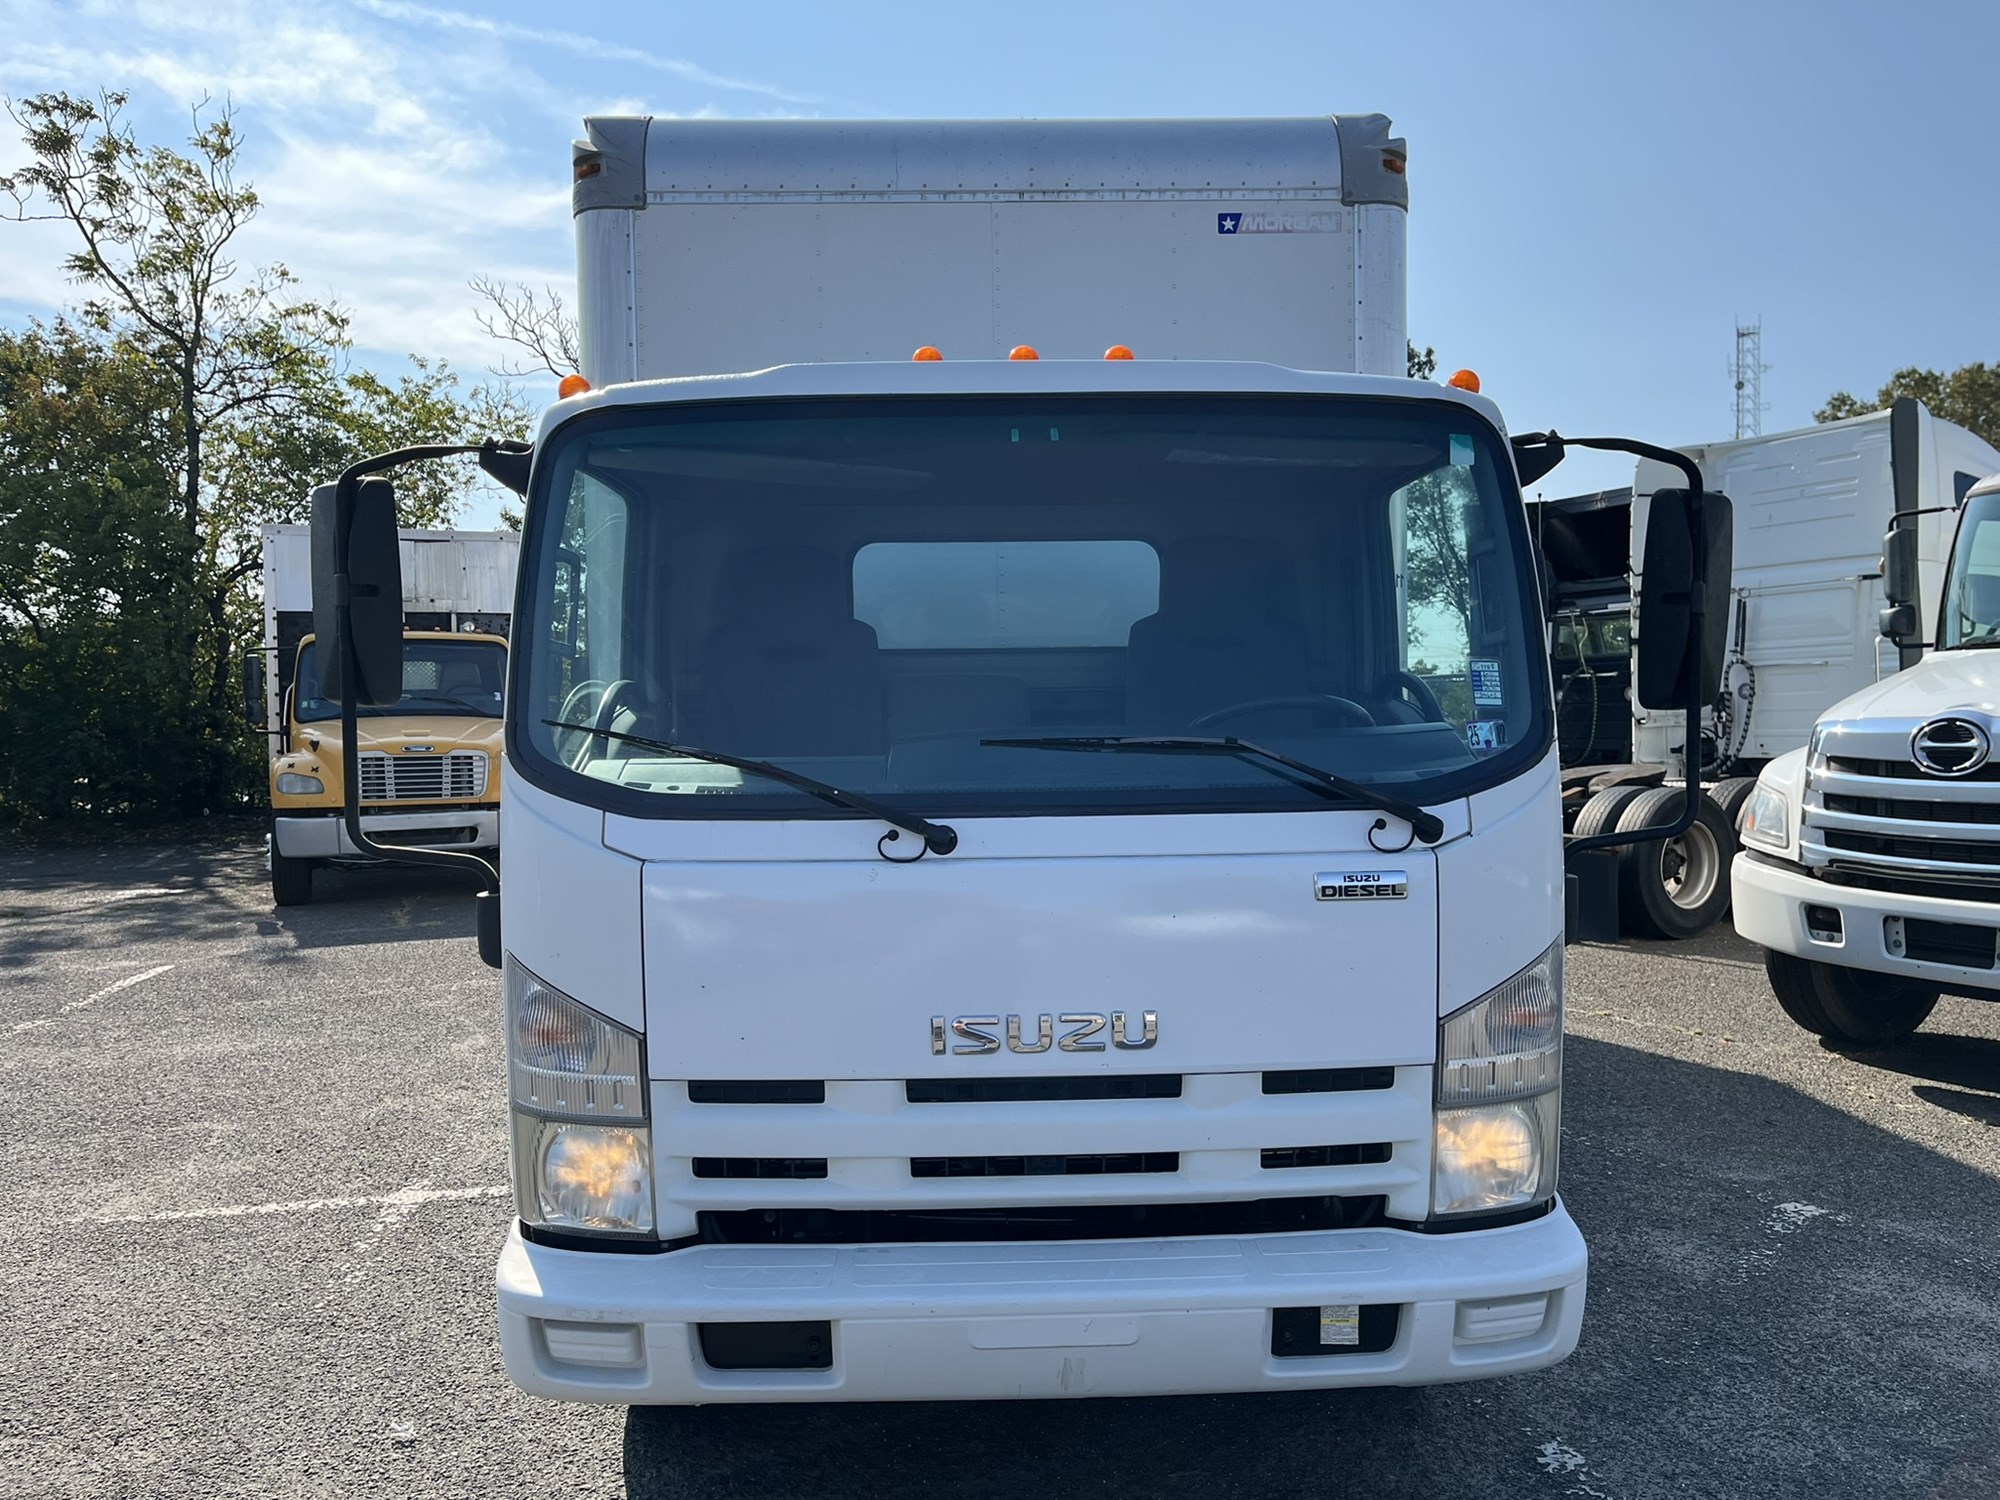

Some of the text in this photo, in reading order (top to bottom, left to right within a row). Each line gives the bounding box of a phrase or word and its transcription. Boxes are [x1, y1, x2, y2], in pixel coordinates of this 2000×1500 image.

[1242, 214, 1337, 231] MORGAN
[1468, 725, 1481, 746] 25
[1343, 874, 1381, 883] ISUZU
[1321, 884, 1405, 898] DIESEL
[930, 1009, 1158, 1056] ISUZU
